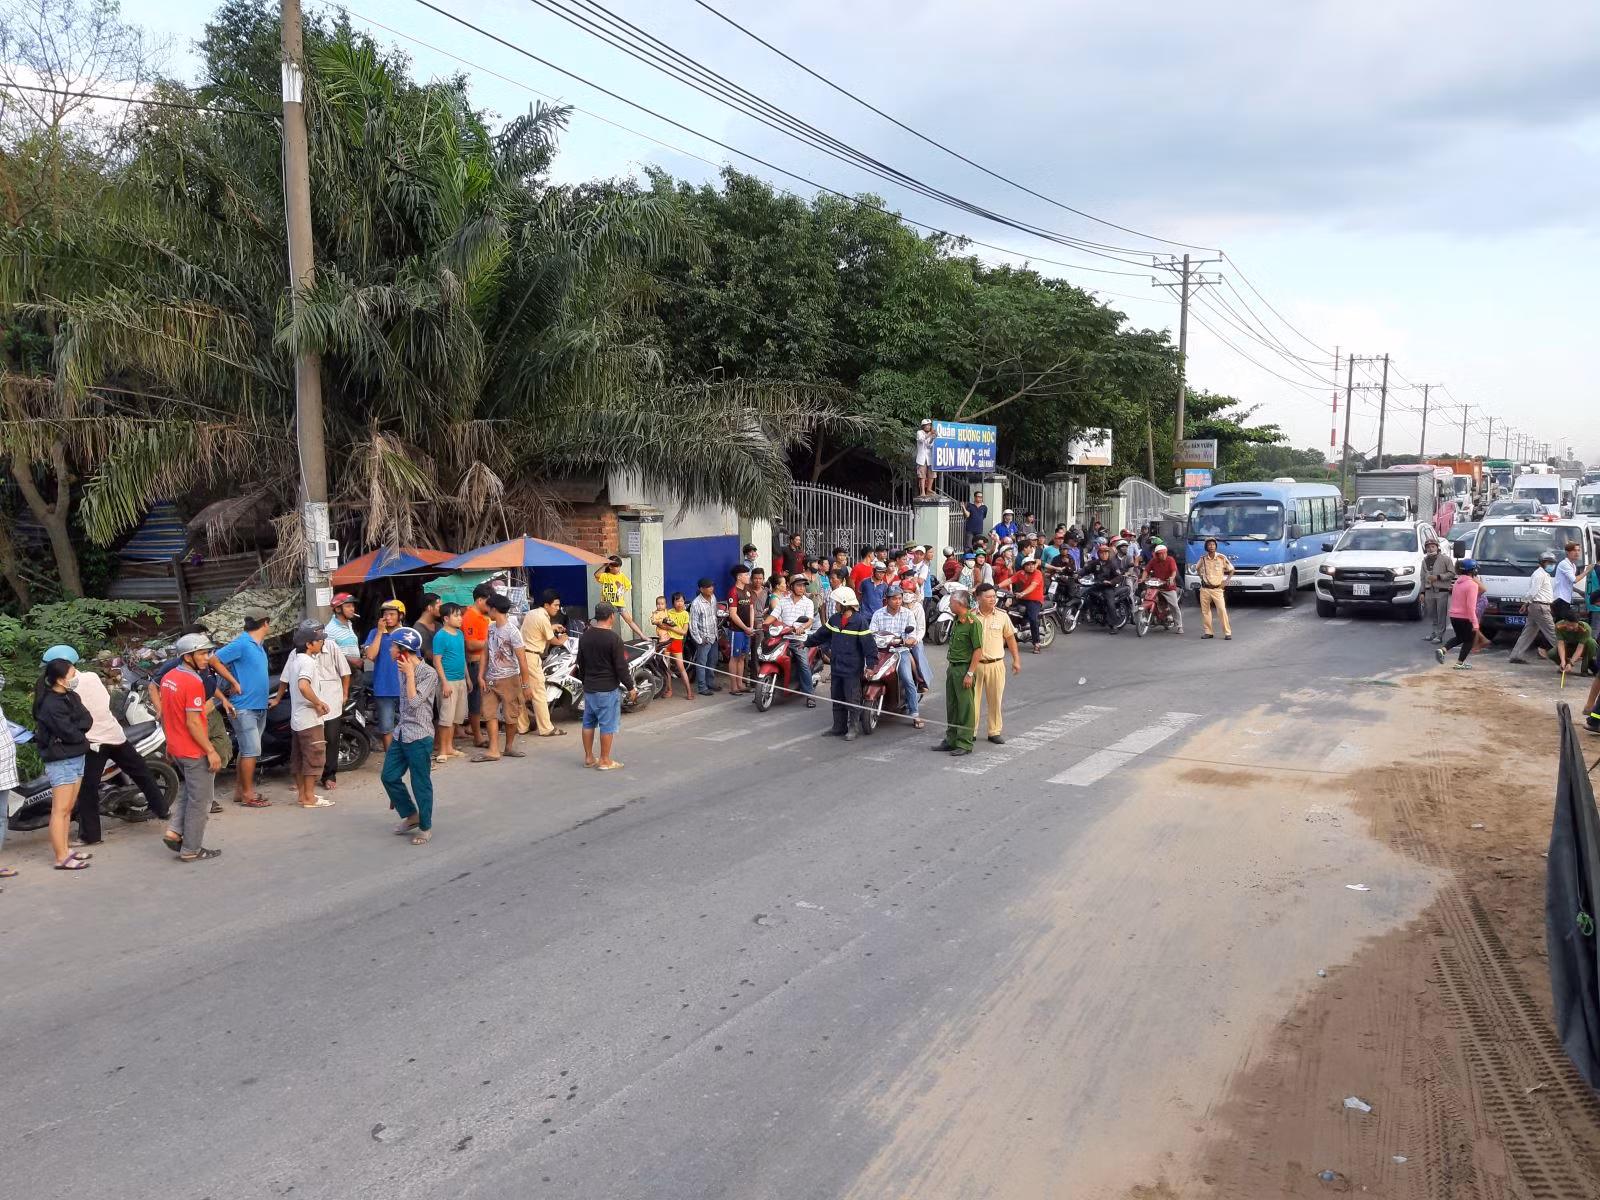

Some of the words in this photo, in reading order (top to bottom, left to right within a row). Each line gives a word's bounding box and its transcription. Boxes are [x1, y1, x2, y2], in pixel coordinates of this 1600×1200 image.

[937, 423, 956, 437] Quán
[936, 442, 955, 467] BÚN
[956, 447, 976, 471] MỌC
[604, 583, 614, 592] PIG
[24, 791, 53, 805] YAMAHA
